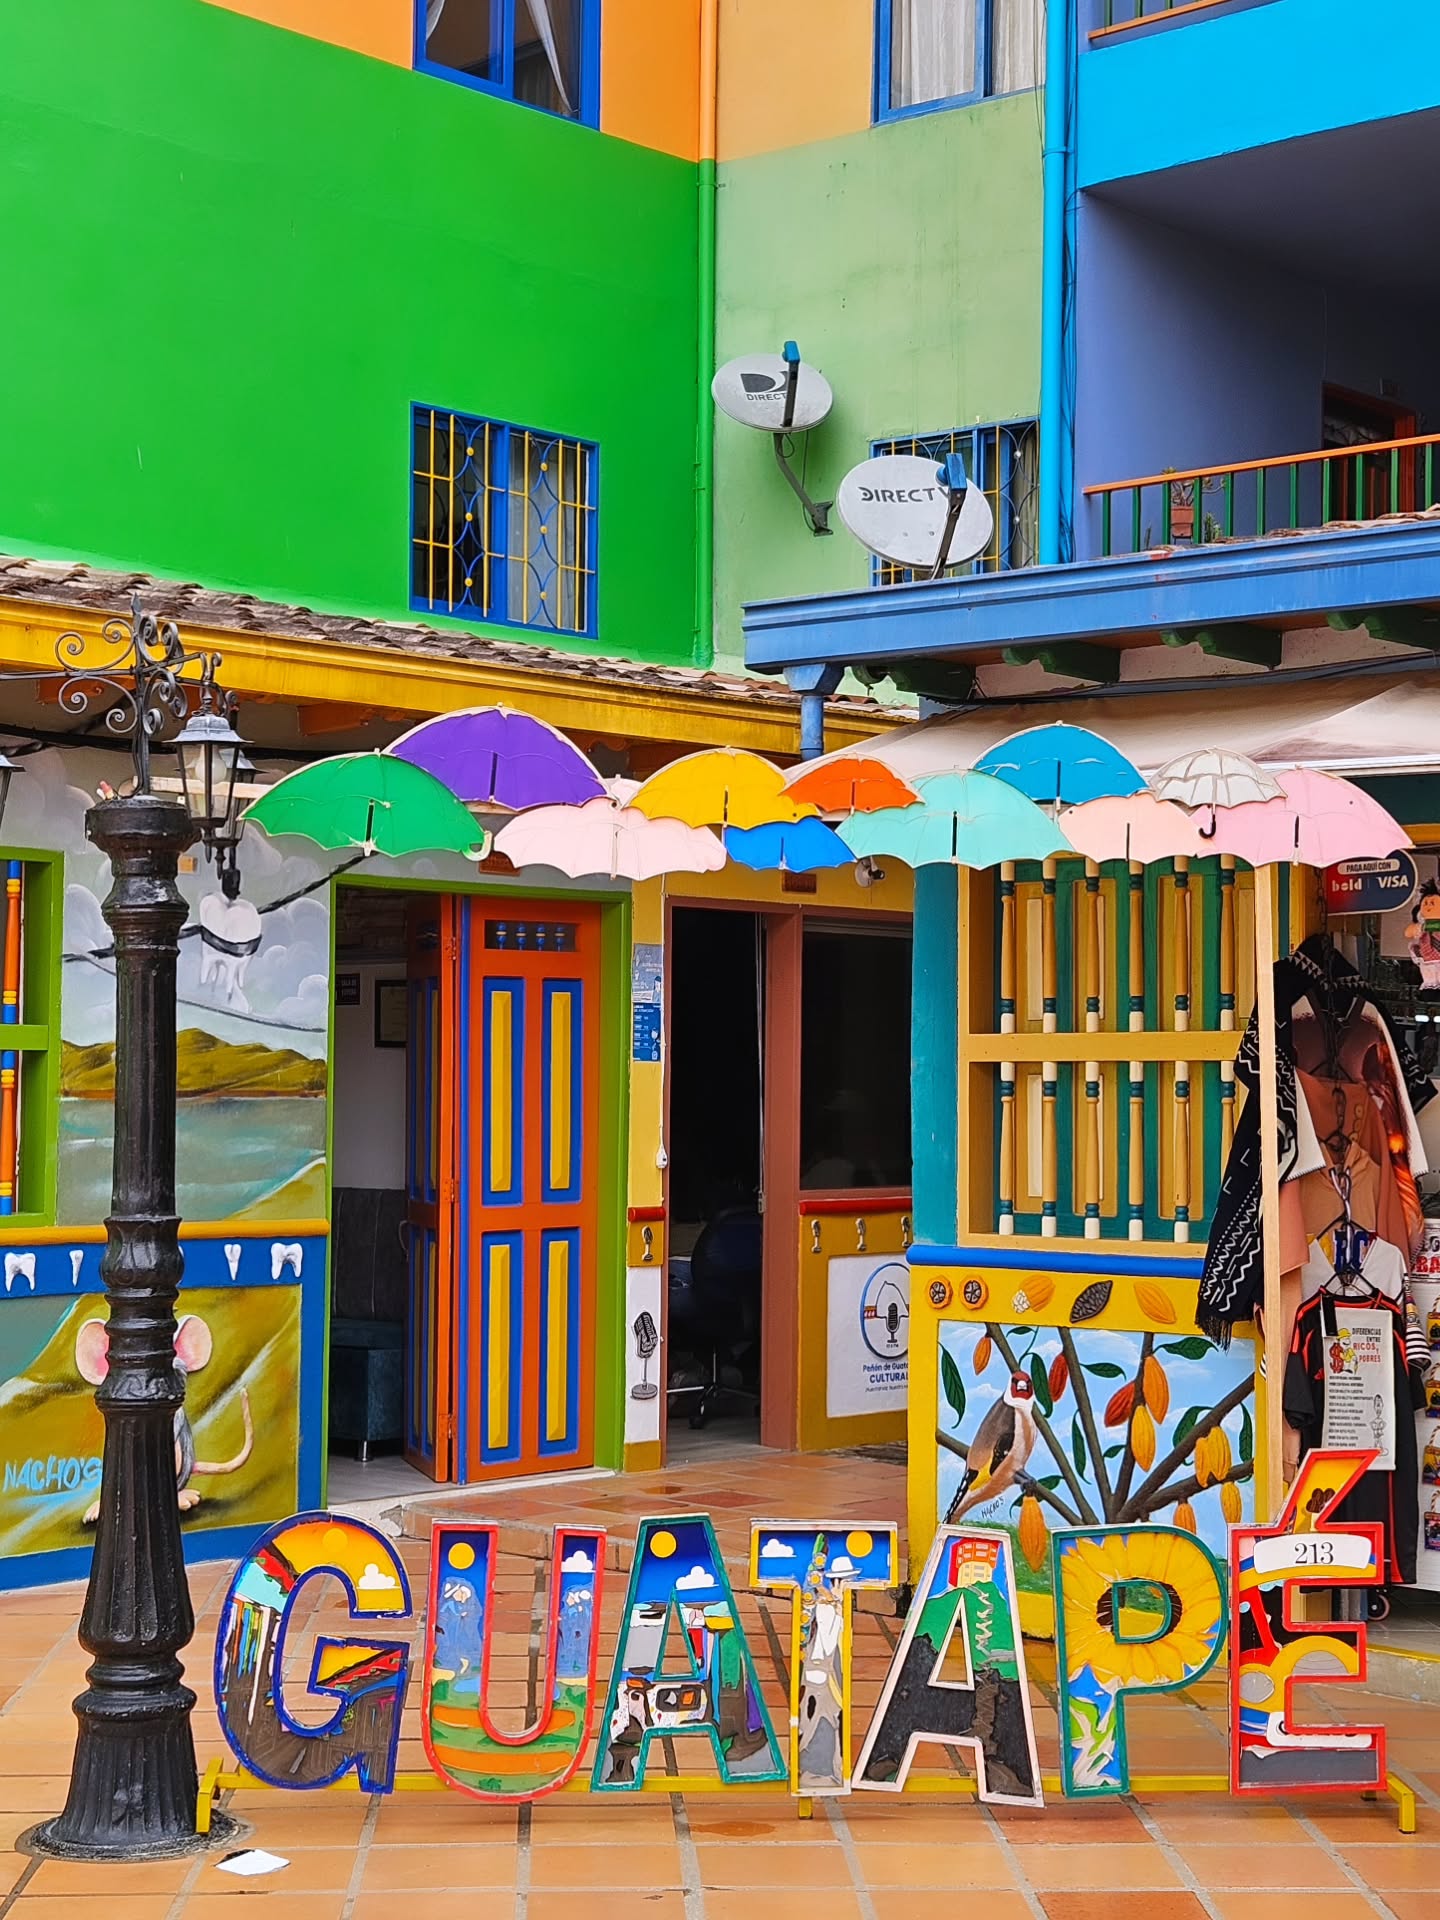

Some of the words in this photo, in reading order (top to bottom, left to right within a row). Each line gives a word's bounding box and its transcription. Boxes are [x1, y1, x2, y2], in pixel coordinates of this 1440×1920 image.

[746, 392, 787, 401] DIRECT
[1346, 864, 1362, 873] PAGA
[1378, 861, 1392, 870] CON
[1332, 878, 1363, 892] bold
[1376, 874, 1409, 889] VISA
[1353, 1342, 1377, 1351] RICOS
[1359, 1354, 1381, 1363] POBRES
[883, 1362, 891, 1371] de
[1294, 1541, 1335, 1565] 213
[213, 1449, 1387, 1808] GUATAPÉ
